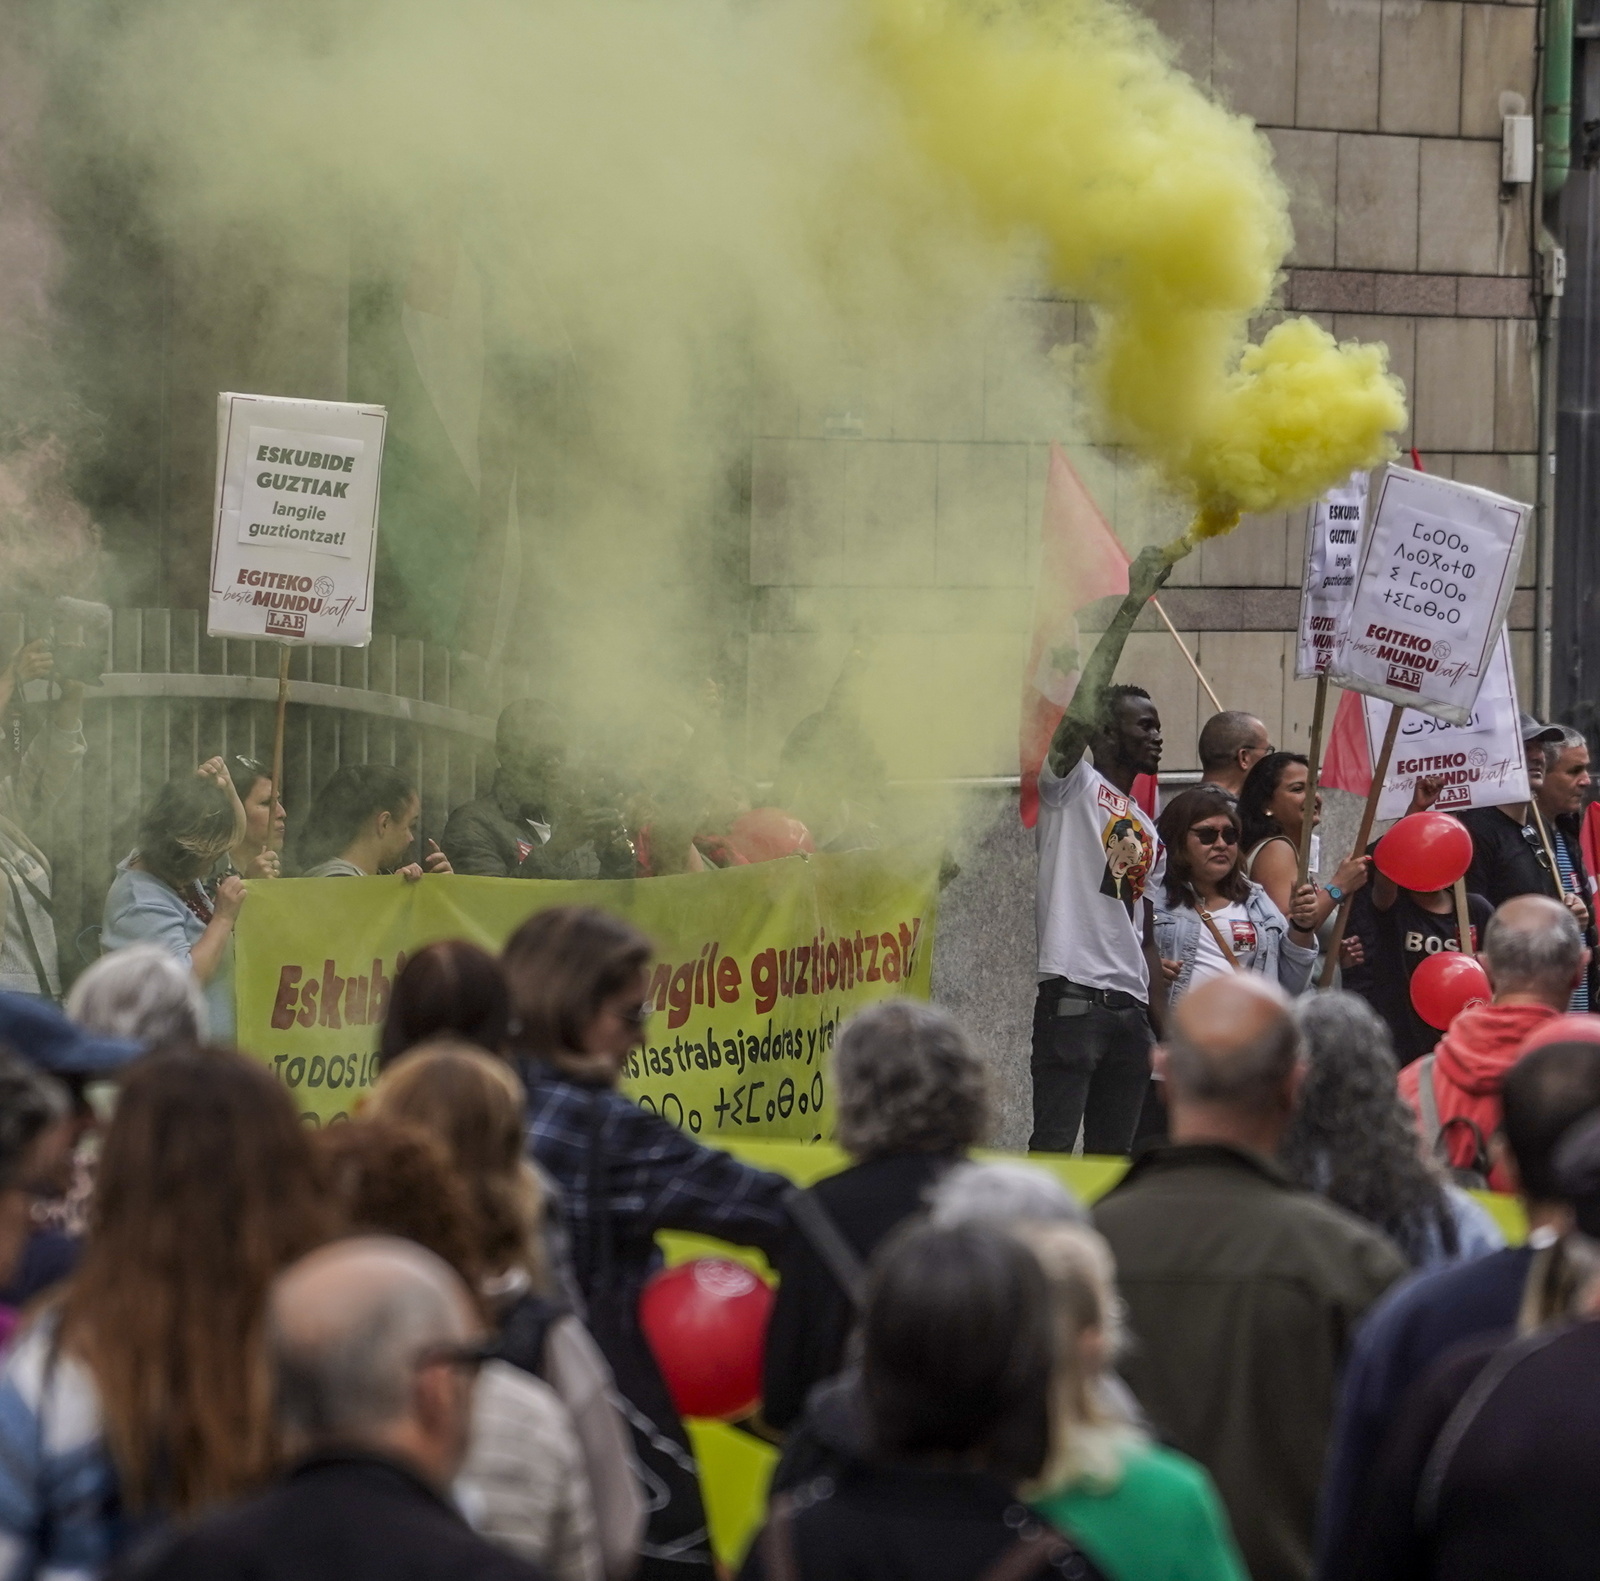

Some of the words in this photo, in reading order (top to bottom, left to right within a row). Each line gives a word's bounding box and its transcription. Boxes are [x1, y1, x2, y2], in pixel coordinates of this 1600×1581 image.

[256, 445, 355, 473] ESKUBIDE
[256, 472, 350, 499] GUZTIAK
[272, 501, 327, 521] langile
[248, 522, 346, 546] guztiontzat!
[237, 568, 313, 593] EGITEKO
[223, 586, 253, 605] beste
[252, 590, 323, 614] MUNDU
[268, 613, 306, 630] LAB
[1365, 624, 1431, 652] EGITEKO
[1352, 637, 1377, 656] beste
[1376, 645, 1440, 673] MUNDU
[1388, 667, 1421, 685] LAB
[1397, 752, 1467, 775] EGITEKO
[1416, 768, 1480, 785] NDU
[1101, 790, 1127, 811] LAB
[270, 950, 407, 1030] Eskub
[645, 942, 742, 1030] ngile
[751, 918, 920, 1015] guztiontzat!
